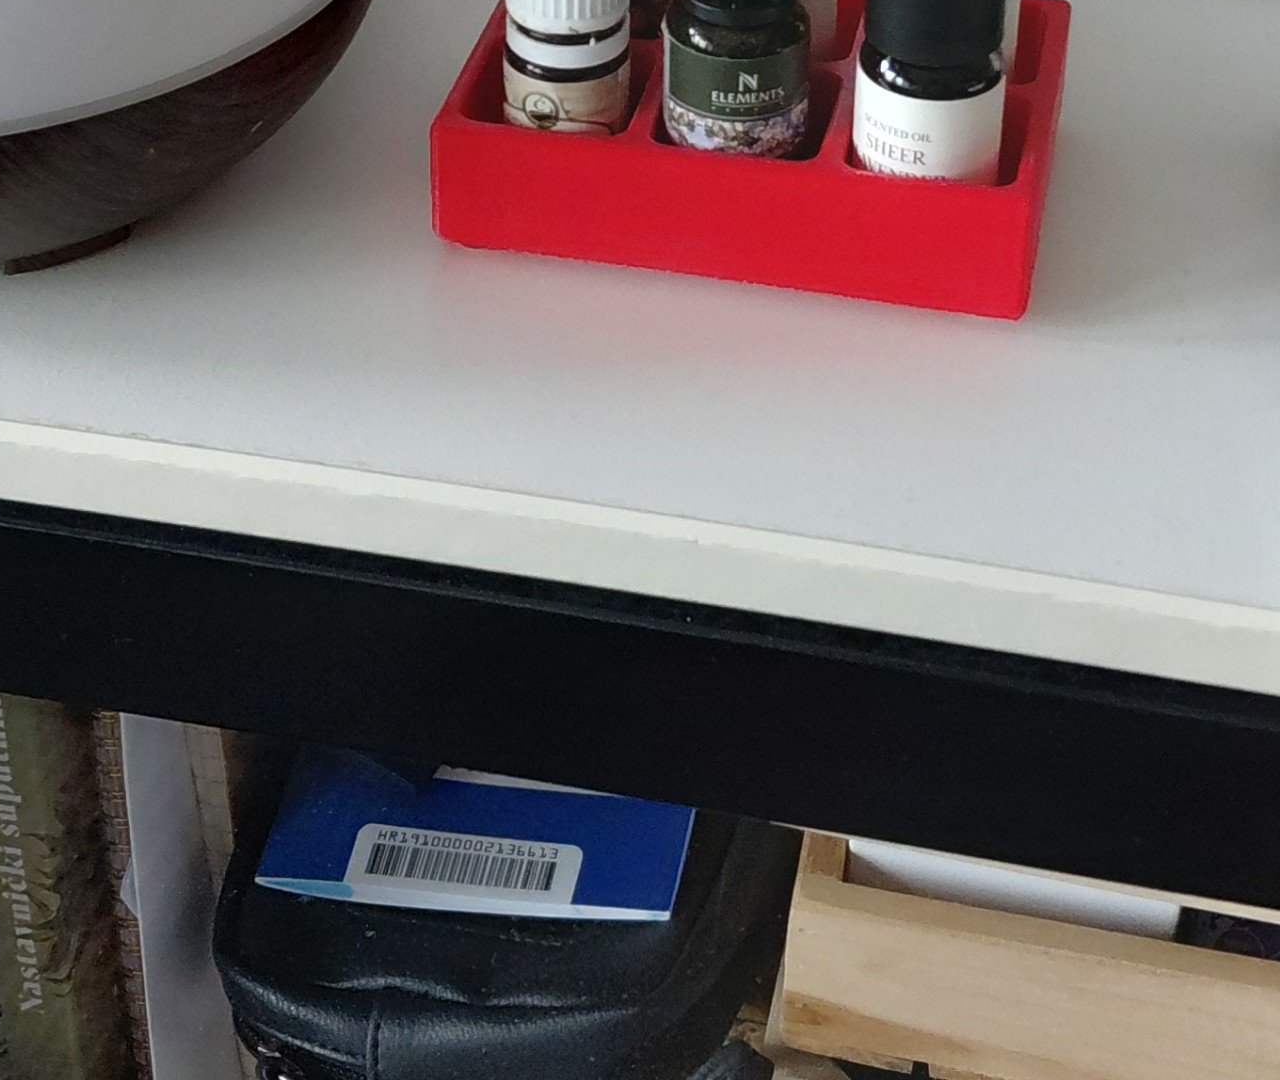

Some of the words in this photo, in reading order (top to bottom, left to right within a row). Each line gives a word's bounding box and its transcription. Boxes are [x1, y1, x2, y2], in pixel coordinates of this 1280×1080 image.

[711, 86, 785, 104] ELEMENTS
[864, 112, 909, 139] SCENTED
[911, 132, 933, 143] OIL
[865, 132, 926, 166] SHEER
[377, 830, 559, 859] HR191000002136613
